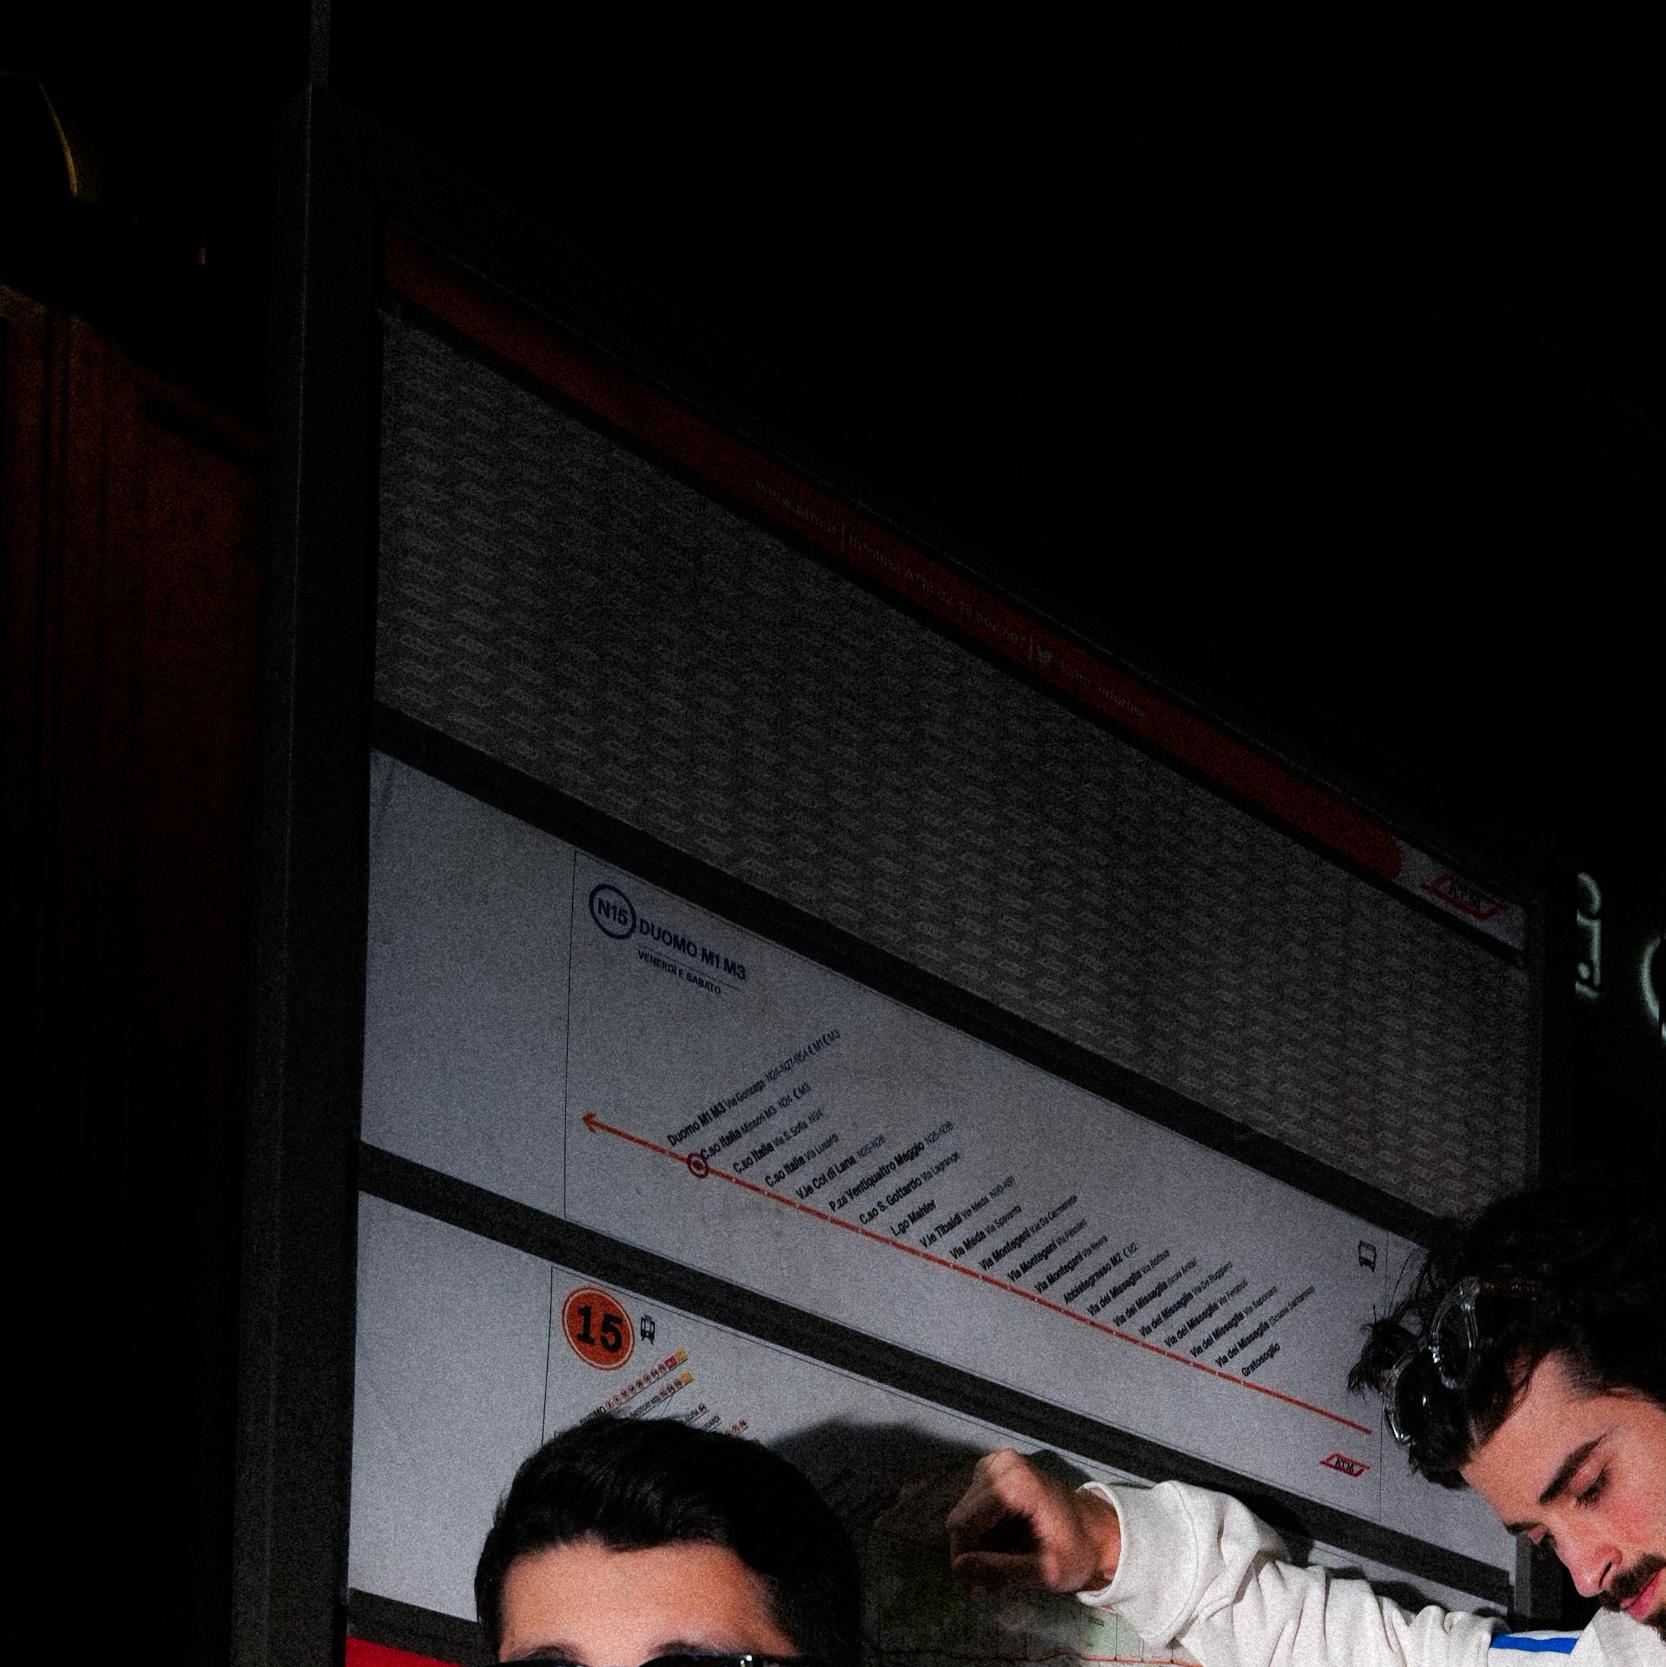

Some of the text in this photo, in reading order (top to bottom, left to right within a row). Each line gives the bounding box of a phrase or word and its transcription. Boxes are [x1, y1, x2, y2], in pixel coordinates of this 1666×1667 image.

[598, 895, 630, 927] N15
[638, 916, 747, 982] DUOMO M1 M3
[686, 970, 722, 995] SABATO
[666, 1121, 701, 1146] Duomo
[698, 1111, 709, 1126] M1
[709, 1102, 726, 1118] M3
[699, 1143, 722, 1160] C.so
[719, 1129, 743, 1148] Italia
[732, 1156, 754, 1174] C.so
[750, 1142, 775, 1161] Italia
[772, 1136, 785, 1148] Via
[764, 1169, 786, 1188] C.so
[783, 1156, 806, 1175] Italia
[803, 1149, 817, 1161] Via
[811, 1173, 828, 1190] Col
[826, 1166, 837, 1180] di
[834, 1155, 857, 1174] Lana
[845, 1161, 897, 1200] Ventiquattro
[893, 1141, 925, 1166] Maggio
[858, 1207, 879, 1225] C.so
[885, 1177, 923, 1206] Gottardo
[907, 1199, 936, 1224] Mahler
[934, 1212, 963, 1237] Tibaldi
[949, 1246, 965, 1260] Via
[962, 1230, 987, 1251] Meda
[979, 1257, 995, 1271] Via
[991, 1228, 1032, 1262] Montegani
[1007, 1269, 1023, 1282] Via
[1019, 1240, 1058, 1273] Montegani
[1109, 1252, 1123, 1267] M2
[1034, 1280, 1049, 1294] Via
[1046, 1252, 1084, 1285] Montegani
[1086, 1303, 1101, 1317] Via
[1099, 1293, 1112, 1308] dei
[1108, 1270, 1143, 1299] Missaglia
[1112, 1314, 1127, 1327] Via
[1125, 1305, 1138, 1319] dei
[1135, 1281, 1169, 1310] Missaglia
[1139, 1325, 1153, 1338] Via
[1150, 1314, 1164, 1329] dei
[1160, 1291, 1194, 1321] Missaglia
[1164, 1335, 1178, 1348] Via
[1176, 1325, 1189, 1339] dei
[1186, 1302, 1220, 1331] Missaglia
[577, 1305, 623, 1353] 15
[1189, 1345, 1204, 1358] Via
[1202, 1335, 1215, 1350] dei
[1211, 1311, 1245, 1341] Missaglia
[1215, 1355, 1229, 1368] Via
[1227, 1345, 1240, 1359] dei
[1237, 1321, 1271, 1350] Missaglia
[1241, 1342, 1281, 1377] Gratosoglio
